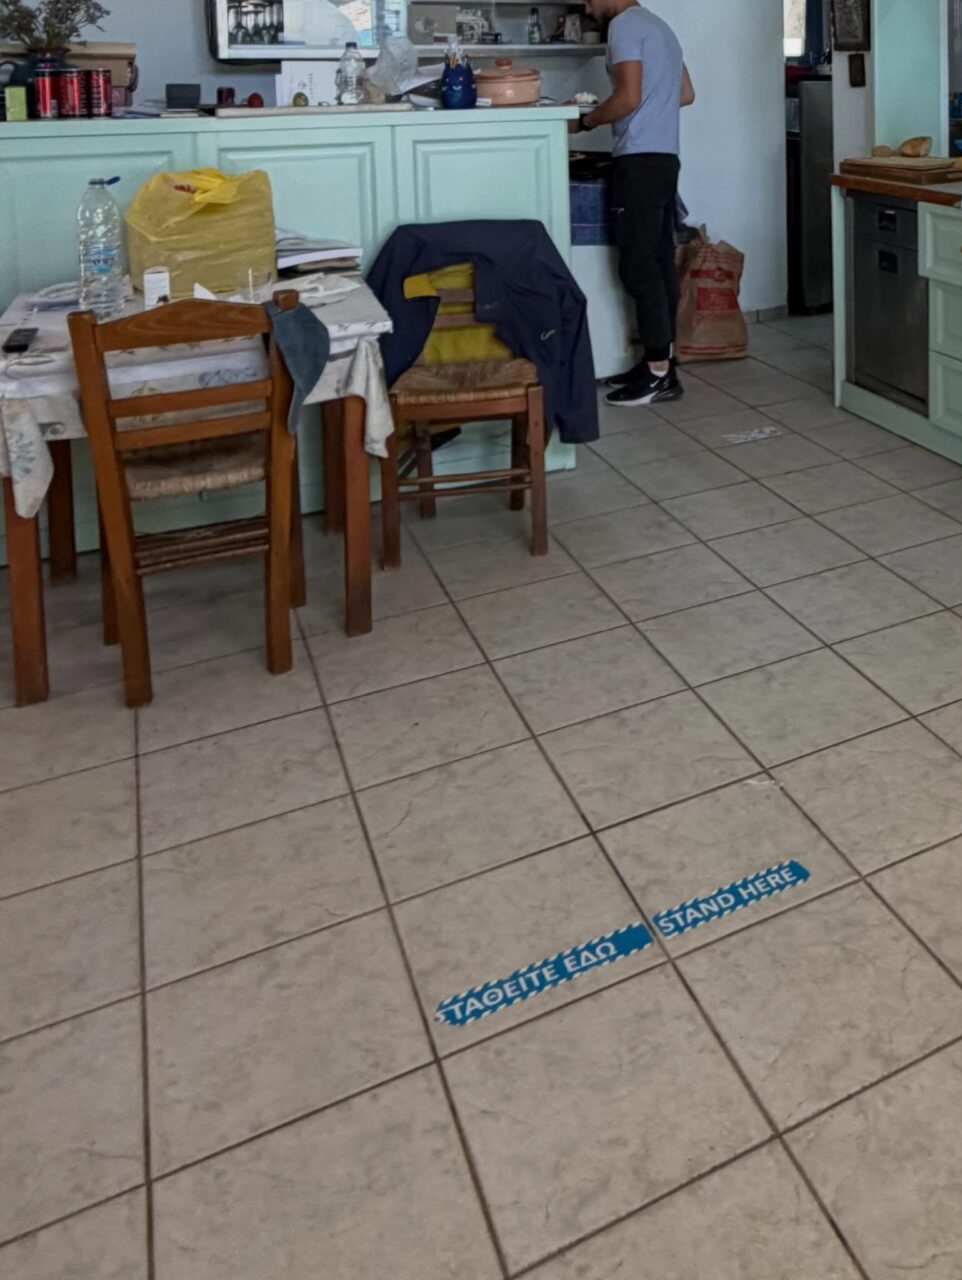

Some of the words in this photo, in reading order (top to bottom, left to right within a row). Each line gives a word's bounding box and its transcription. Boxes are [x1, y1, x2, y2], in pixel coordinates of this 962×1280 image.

[659, 893, 735, 933] STAND
[738, 867, 797, 899] HERE
[563, 942, 618, 972] ΕΔΩ
